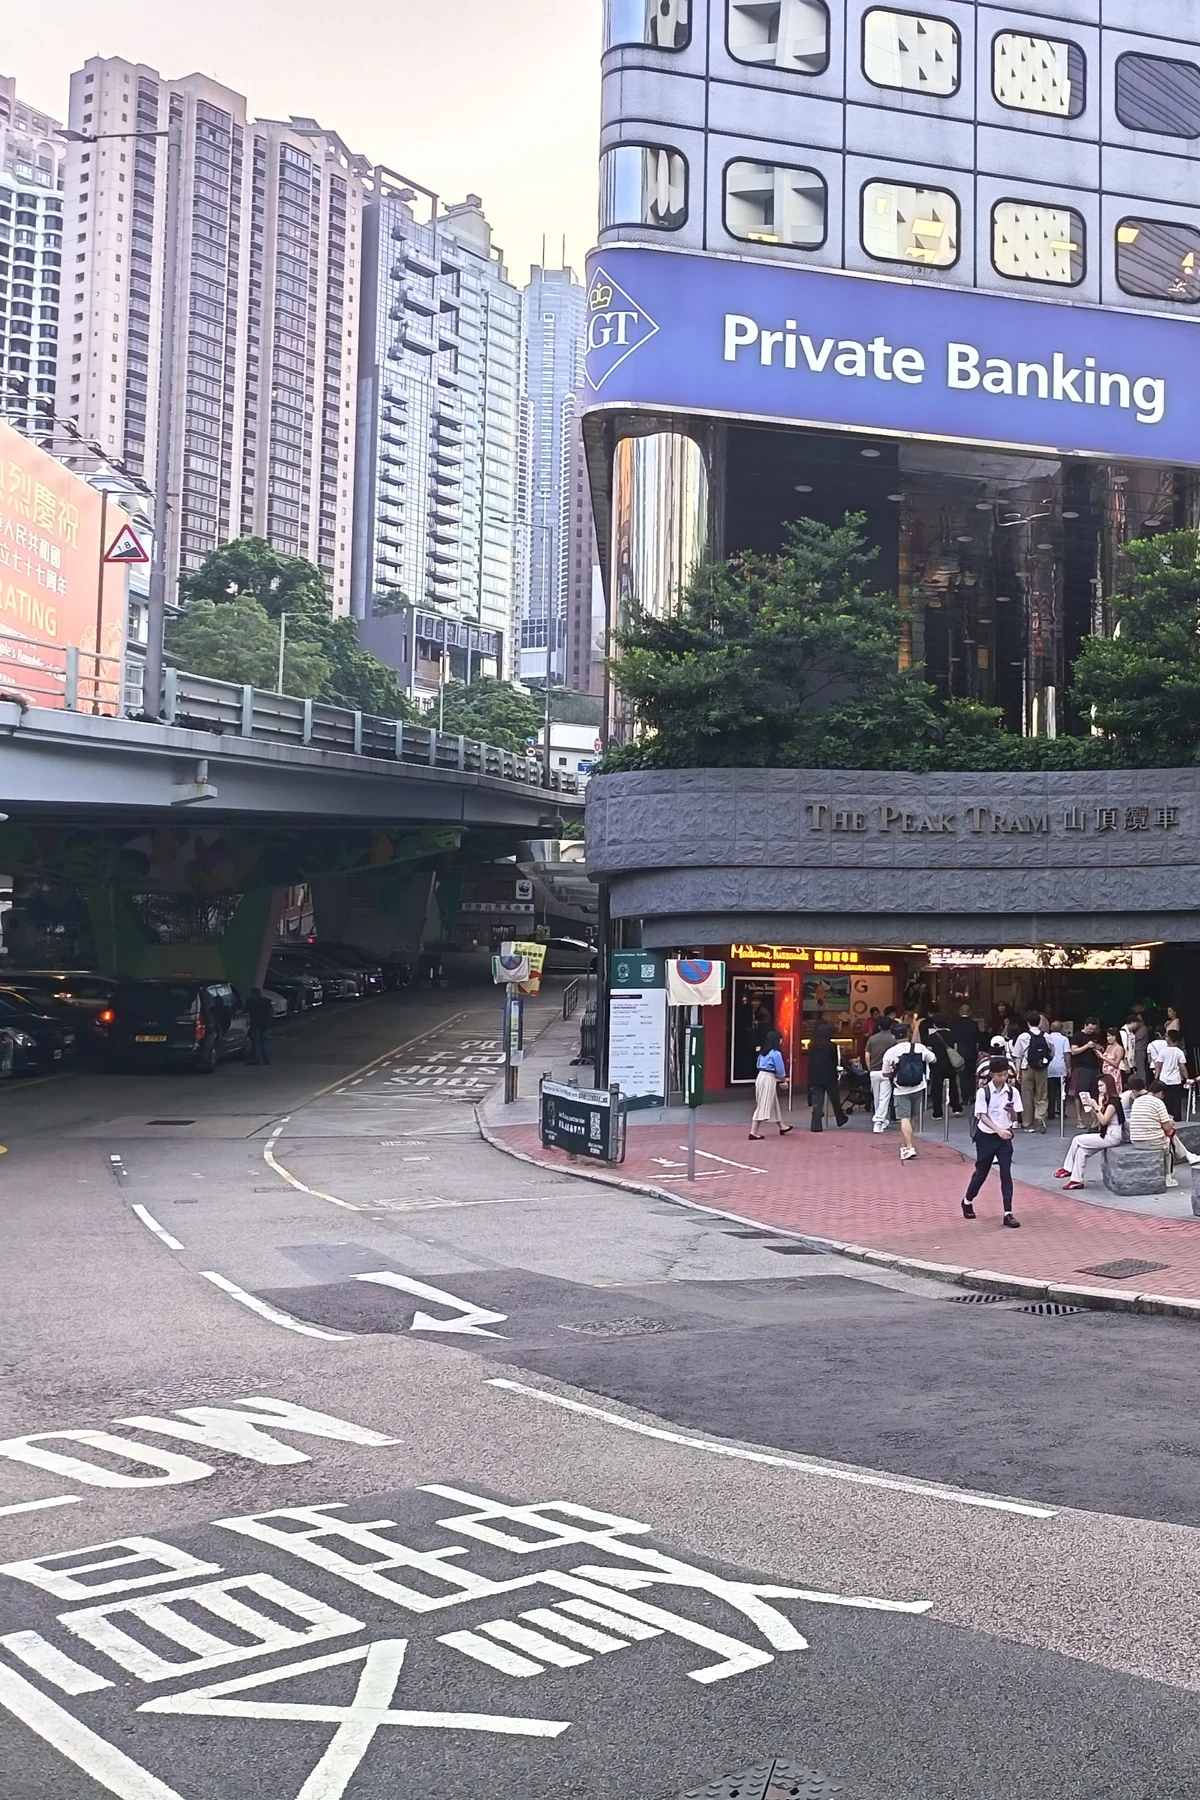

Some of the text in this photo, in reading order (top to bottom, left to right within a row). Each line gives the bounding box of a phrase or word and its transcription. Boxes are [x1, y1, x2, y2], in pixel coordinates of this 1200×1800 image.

[723, 313, 1165, 424] Private Banking
[805, 804, 1179, 833] THE PEAK TRAM 山頂纜車
[731, 944, 809, 961] Madame Tussauds
[383, 1077, 479, 1086] BUS
[393, 1065, 500, 1075] STOP
[0, 1396, 405, 1516] OW
